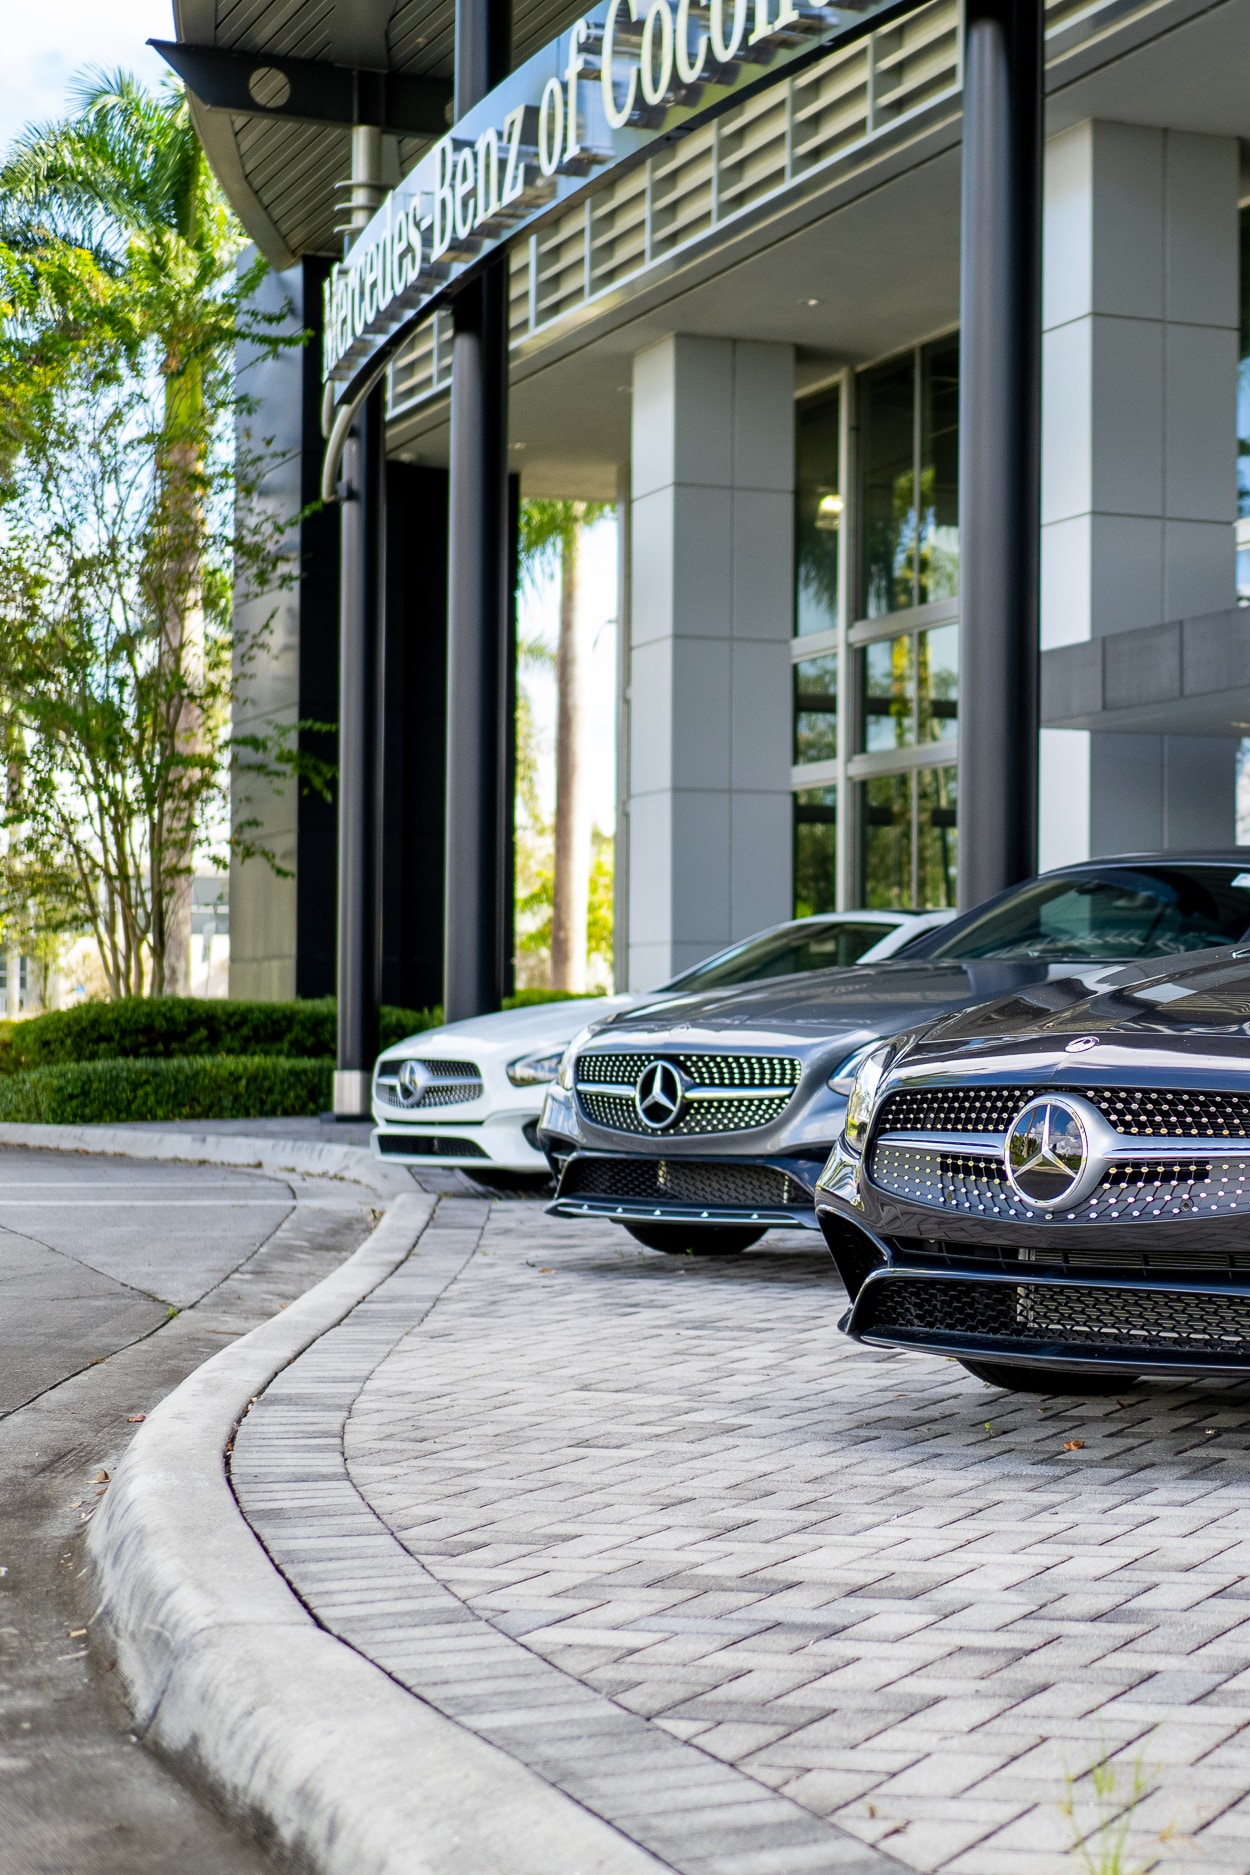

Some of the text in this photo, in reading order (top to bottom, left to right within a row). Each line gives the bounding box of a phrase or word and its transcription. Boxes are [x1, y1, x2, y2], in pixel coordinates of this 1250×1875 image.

[322, 0, 828, 384] Mercedes-Benz of Coco
